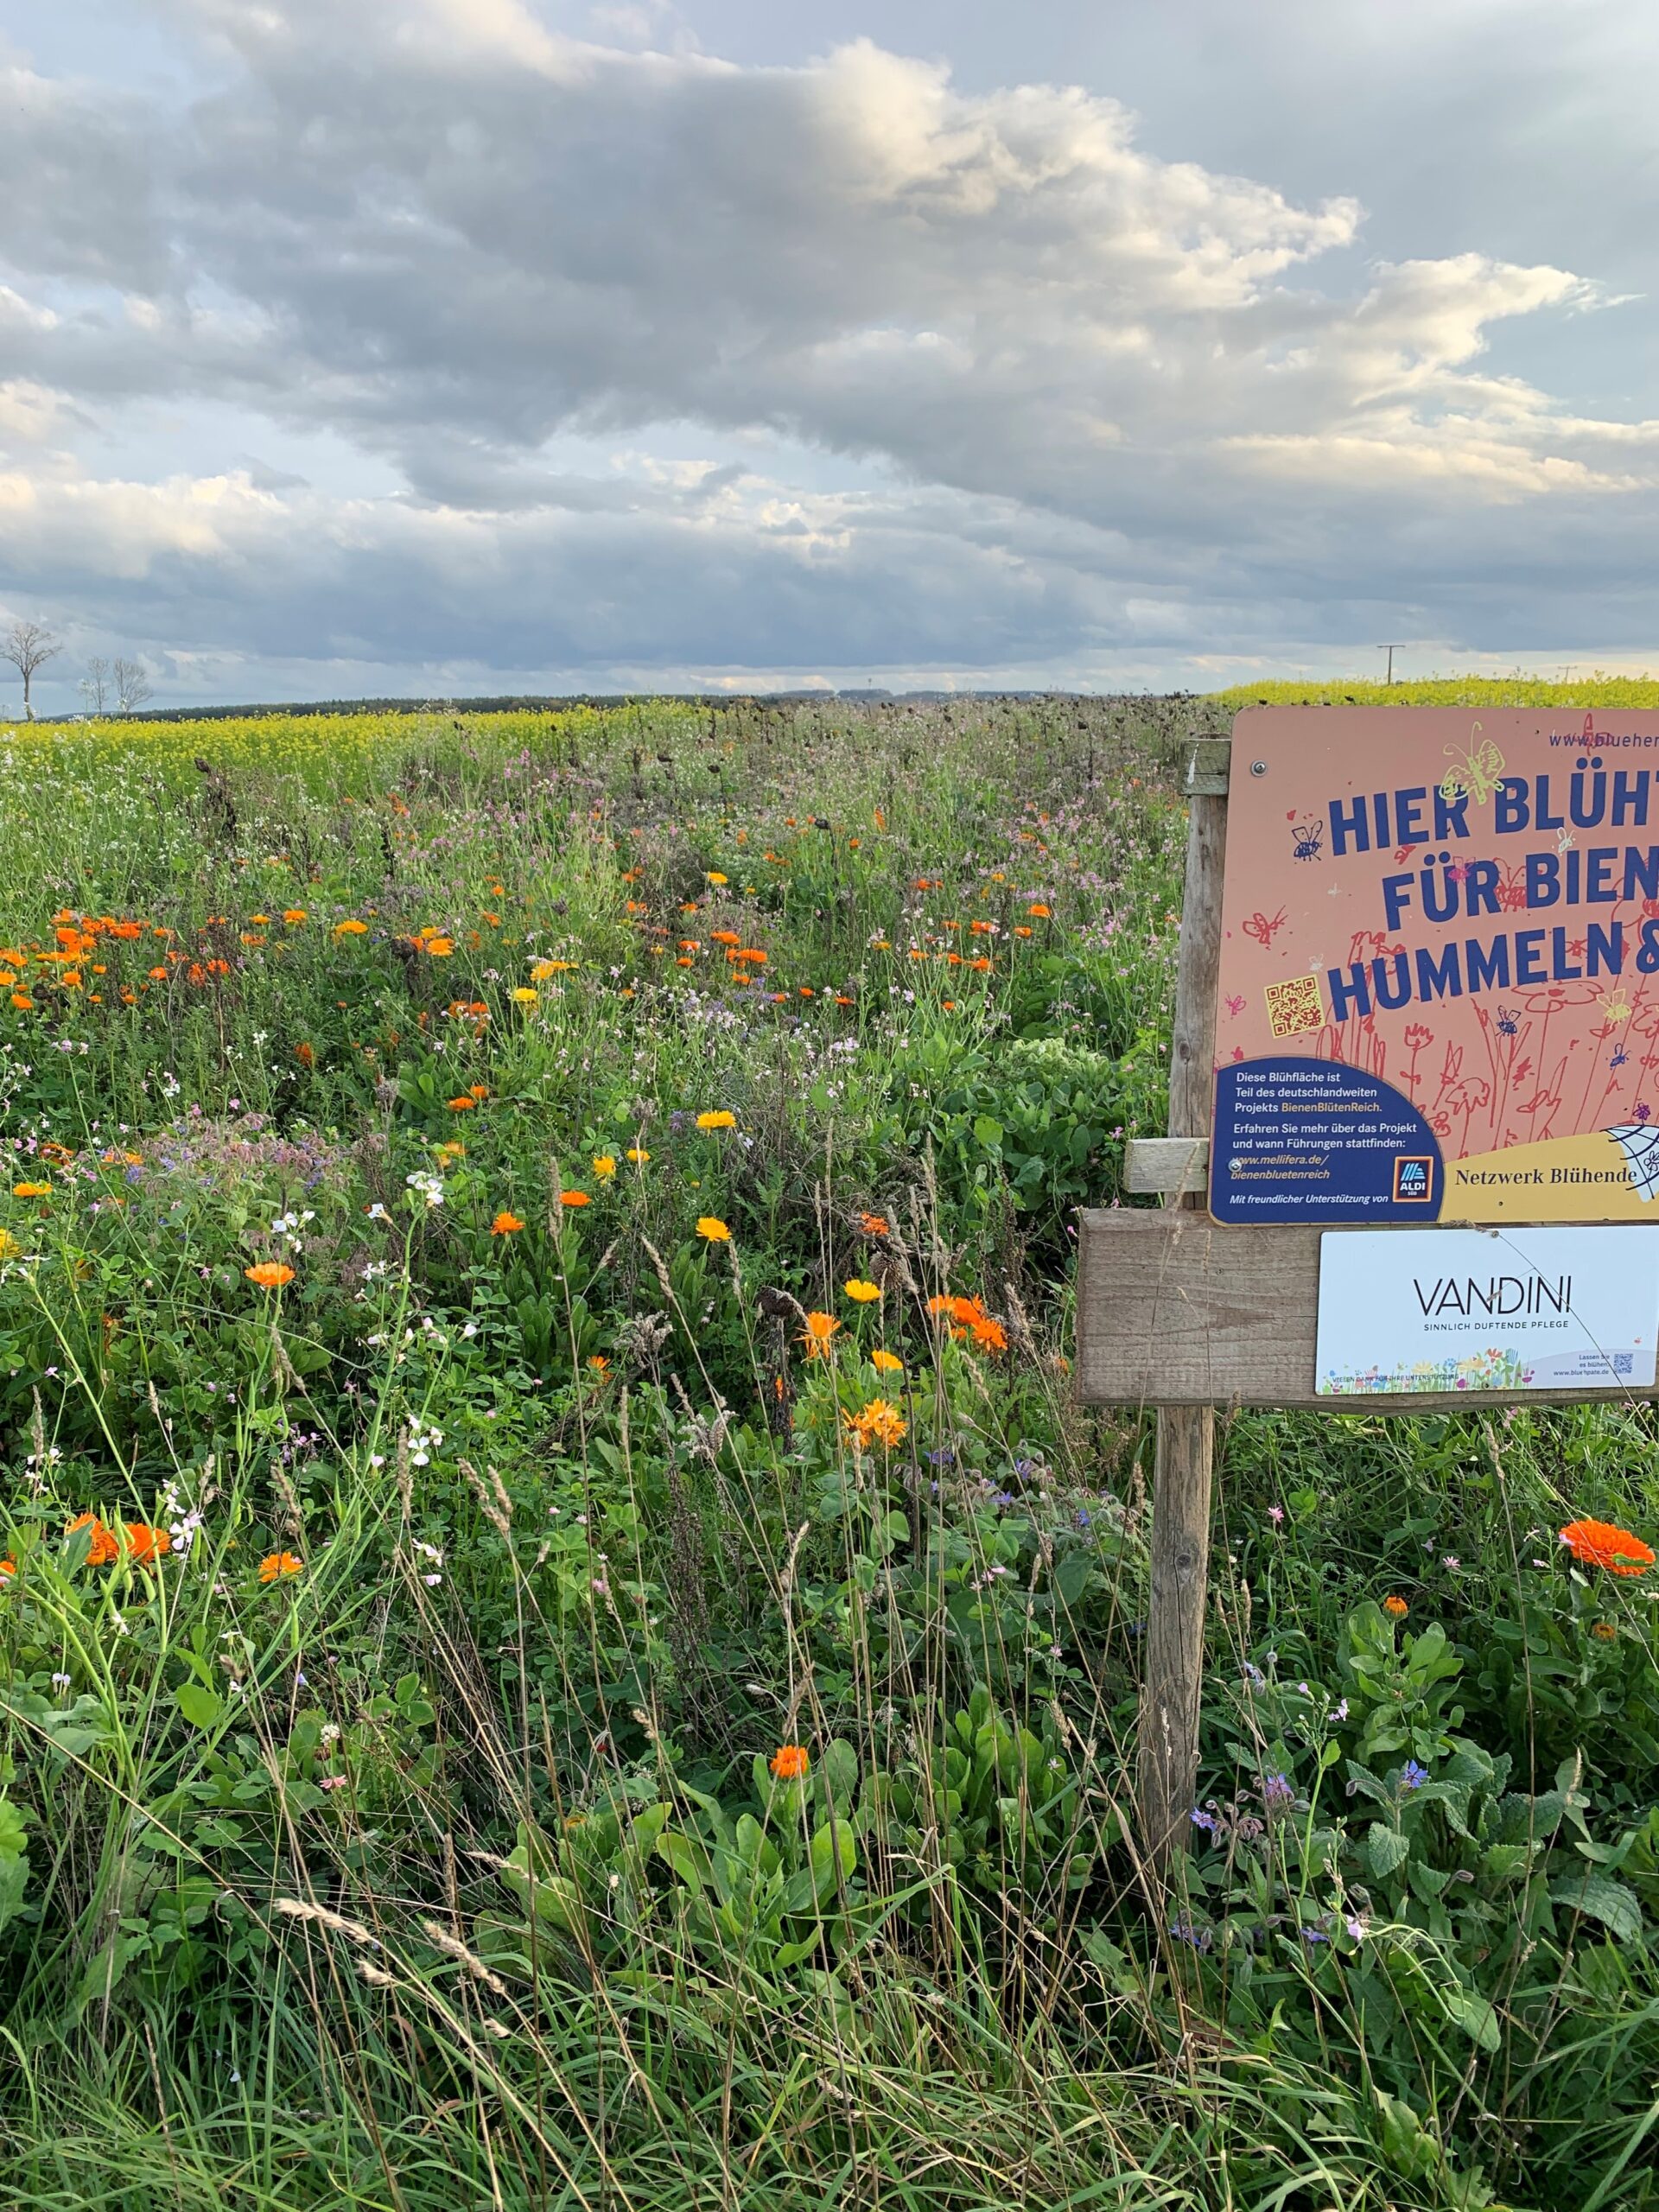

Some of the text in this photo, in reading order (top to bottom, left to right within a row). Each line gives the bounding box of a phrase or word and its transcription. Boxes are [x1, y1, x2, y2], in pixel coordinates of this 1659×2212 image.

[1328, 756, 1659, 856] HIER BLÜH
[1382, 851, 1502, 931] FÜR
[1327, 921, 1623, 1023] HUMMELN
[1236, 1071, 1341, 1083] Diese Blühfläche ist
[1236, 1087, 1377, 1097] Teil des deutschlandweiten
[1235, 1102, 1382, 1115] Projekts BienenBlütenReich.
[1234, 1122, 1417, 1135] Erfahren Sie mehr über das Projekt
[1232, 1137, 1406, 1151] und wann Führungen stattfinden:
[1230, 1169, 1331, 1180] bienenbluetenreich
[1455, 1166, 1638, 1185] Netzwerk Blühende
[1400, 1182, 1426, 1191] ALDI
[1230, 1194, 1246, 1204] Mit
[1247, 1194, 1304, 1205] freundlicher
[1306, 1193, 1370, 1205] Unterstützung
[1413, 1275, 1572, 1316] VANDINI
[1424, 1320, 1569, 1332] SINNLICH DUFTENDE PFLEGE
